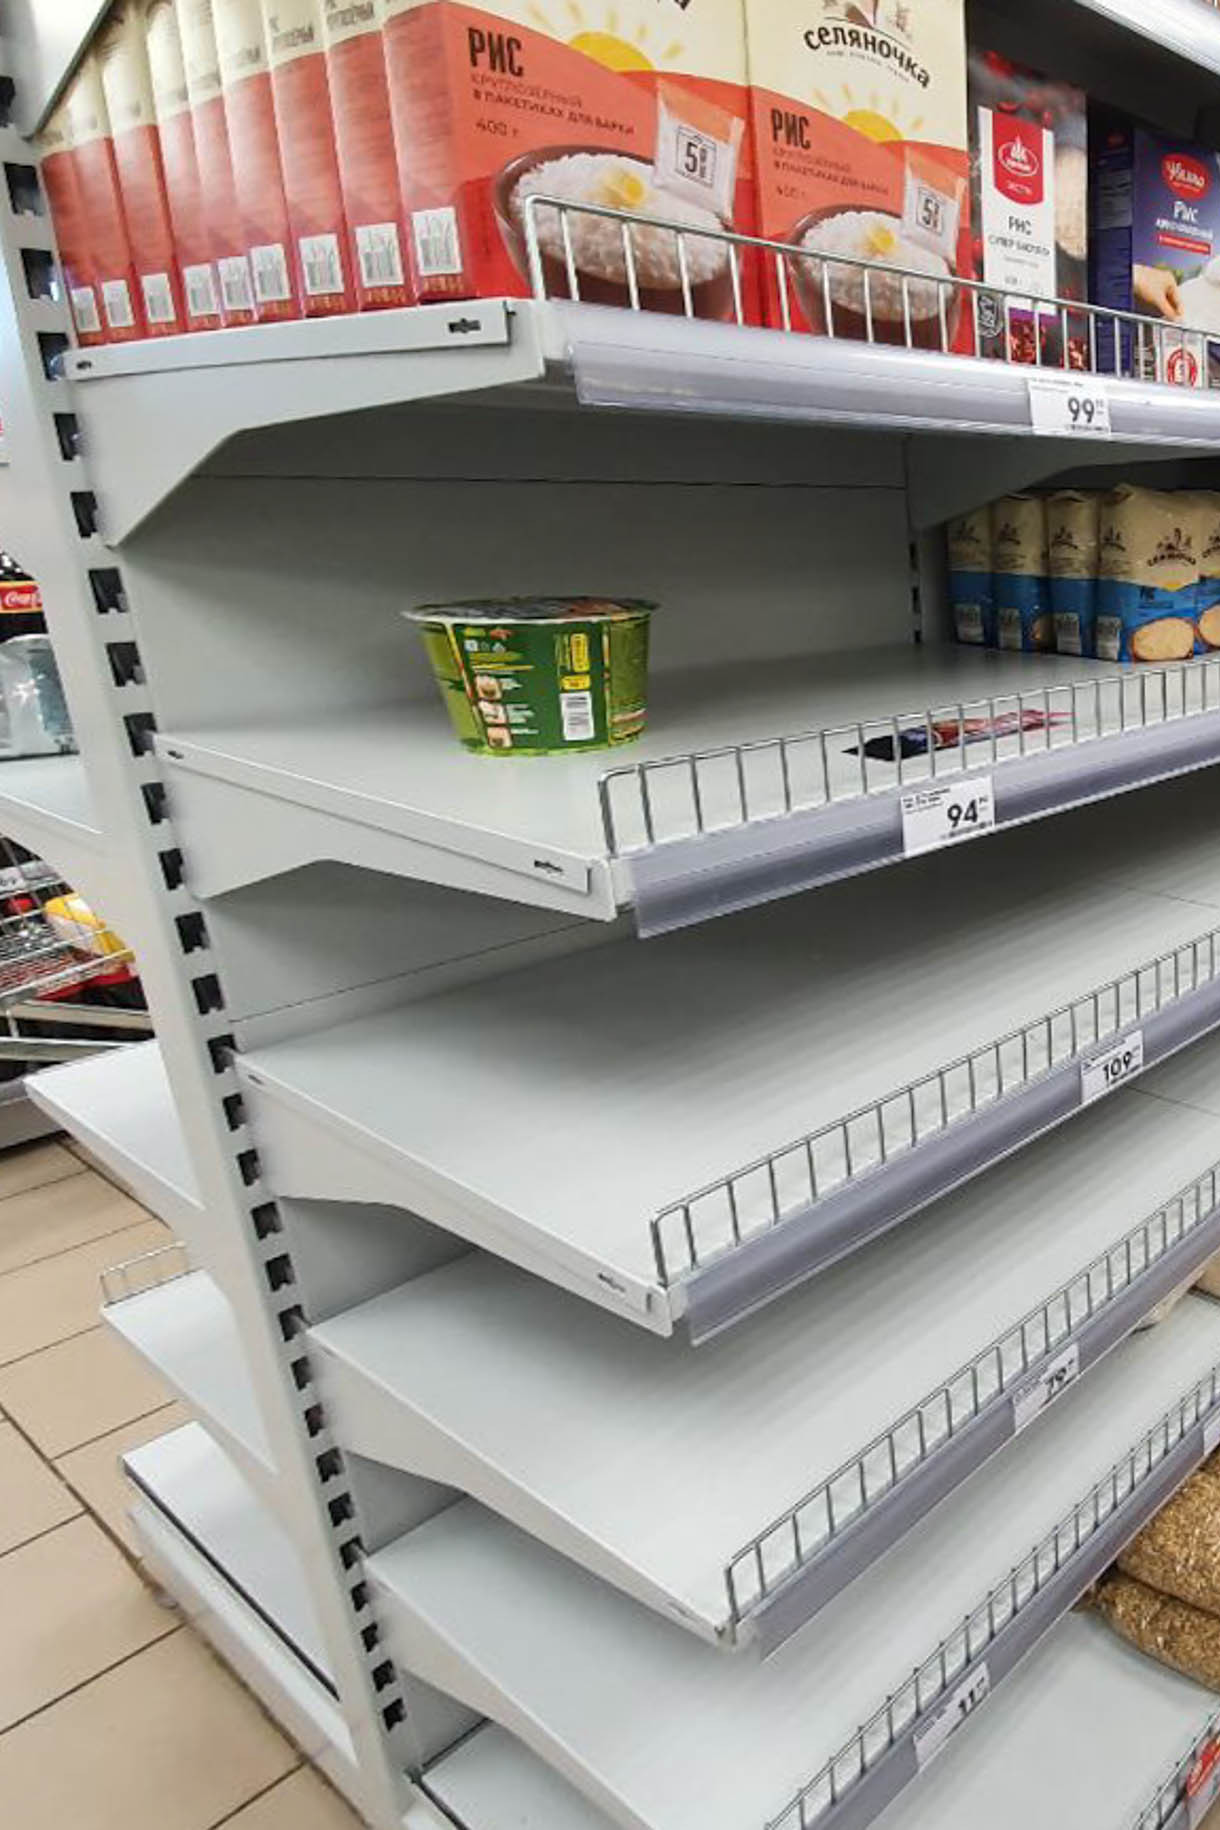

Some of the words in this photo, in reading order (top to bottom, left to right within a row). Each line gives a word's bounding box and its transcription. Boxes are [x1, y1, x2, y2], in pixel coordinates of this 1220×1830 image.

[467, 27, 525, 77] РИС
[771, 108, 811, 150] РИС
[1068, 397, 1095, 423] 99
[946, 799, 978, 828] 94
[1103, 1050, 1132, 1082] 109
